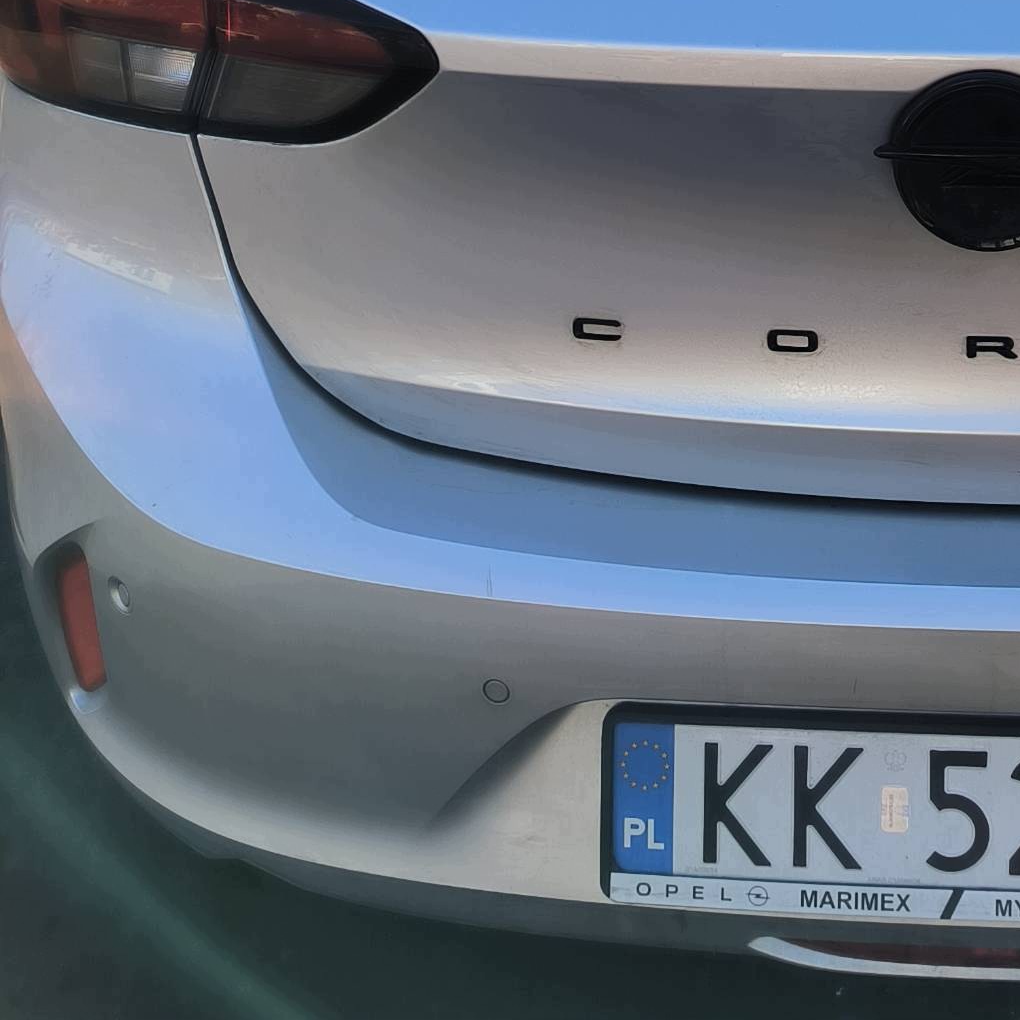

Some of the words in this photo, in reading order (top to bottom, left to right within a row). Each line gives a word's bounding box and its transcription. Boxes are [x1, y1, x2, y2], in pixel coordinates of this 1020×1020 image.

[702, 741, 864, 870] KK
[623, 817, 665, 850] PL
[636, 881, 732, 902] OPEL
[800, 889, 911, 913] MARIMEX
